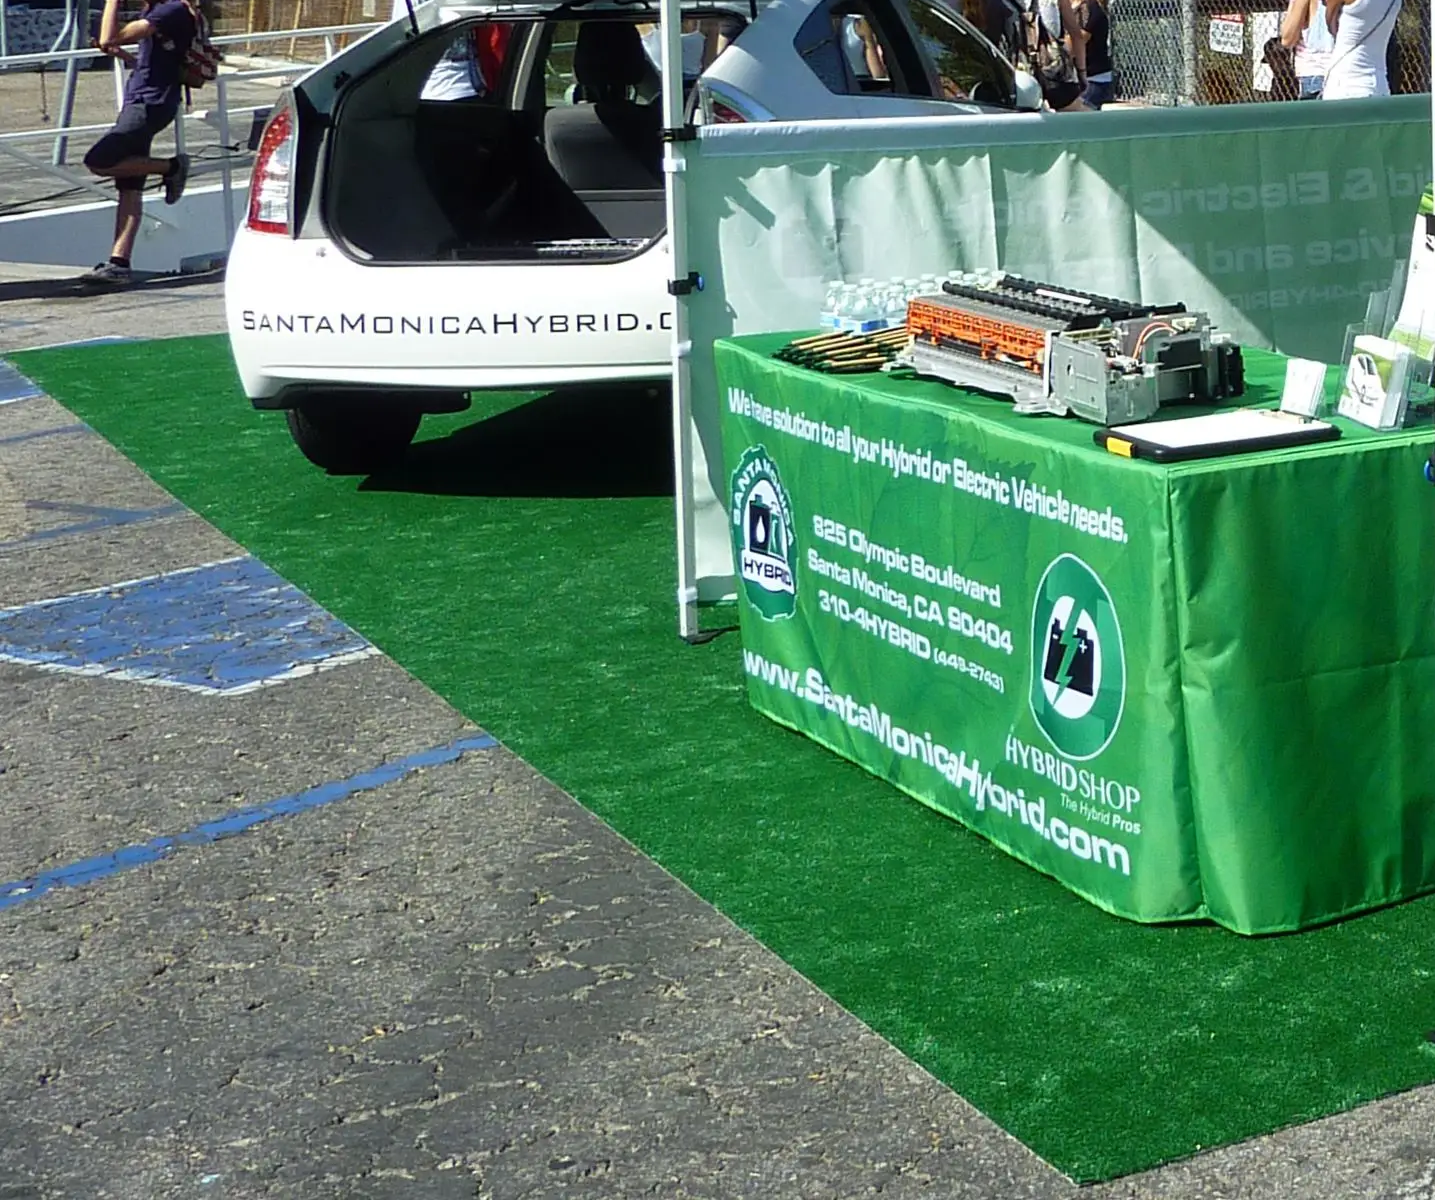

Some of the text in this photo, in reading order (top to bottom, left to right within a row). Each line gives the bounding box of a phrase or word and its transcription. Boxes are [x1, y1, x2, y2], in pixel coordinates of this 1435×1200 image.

[242, 310, 673, 335] SANTAMONICAHYBRID.C
[728, 387, 1129, 544] We have solution to all your Hybrid or Electric Vehicle needs.
[733, 458, 763, 526] SANTA
[807, 548, 1014, 655] Santa Monica, CA 90404
[813, 514, 1001, 609] 825 Olympic Boulevard
[818, 589, 931, 660] 310-4HYBRID
[743, 648, 1131, 876] www.SantaMonicaHybrid.com
[1060, 792, 1142, 835] The Hybrid Pros
